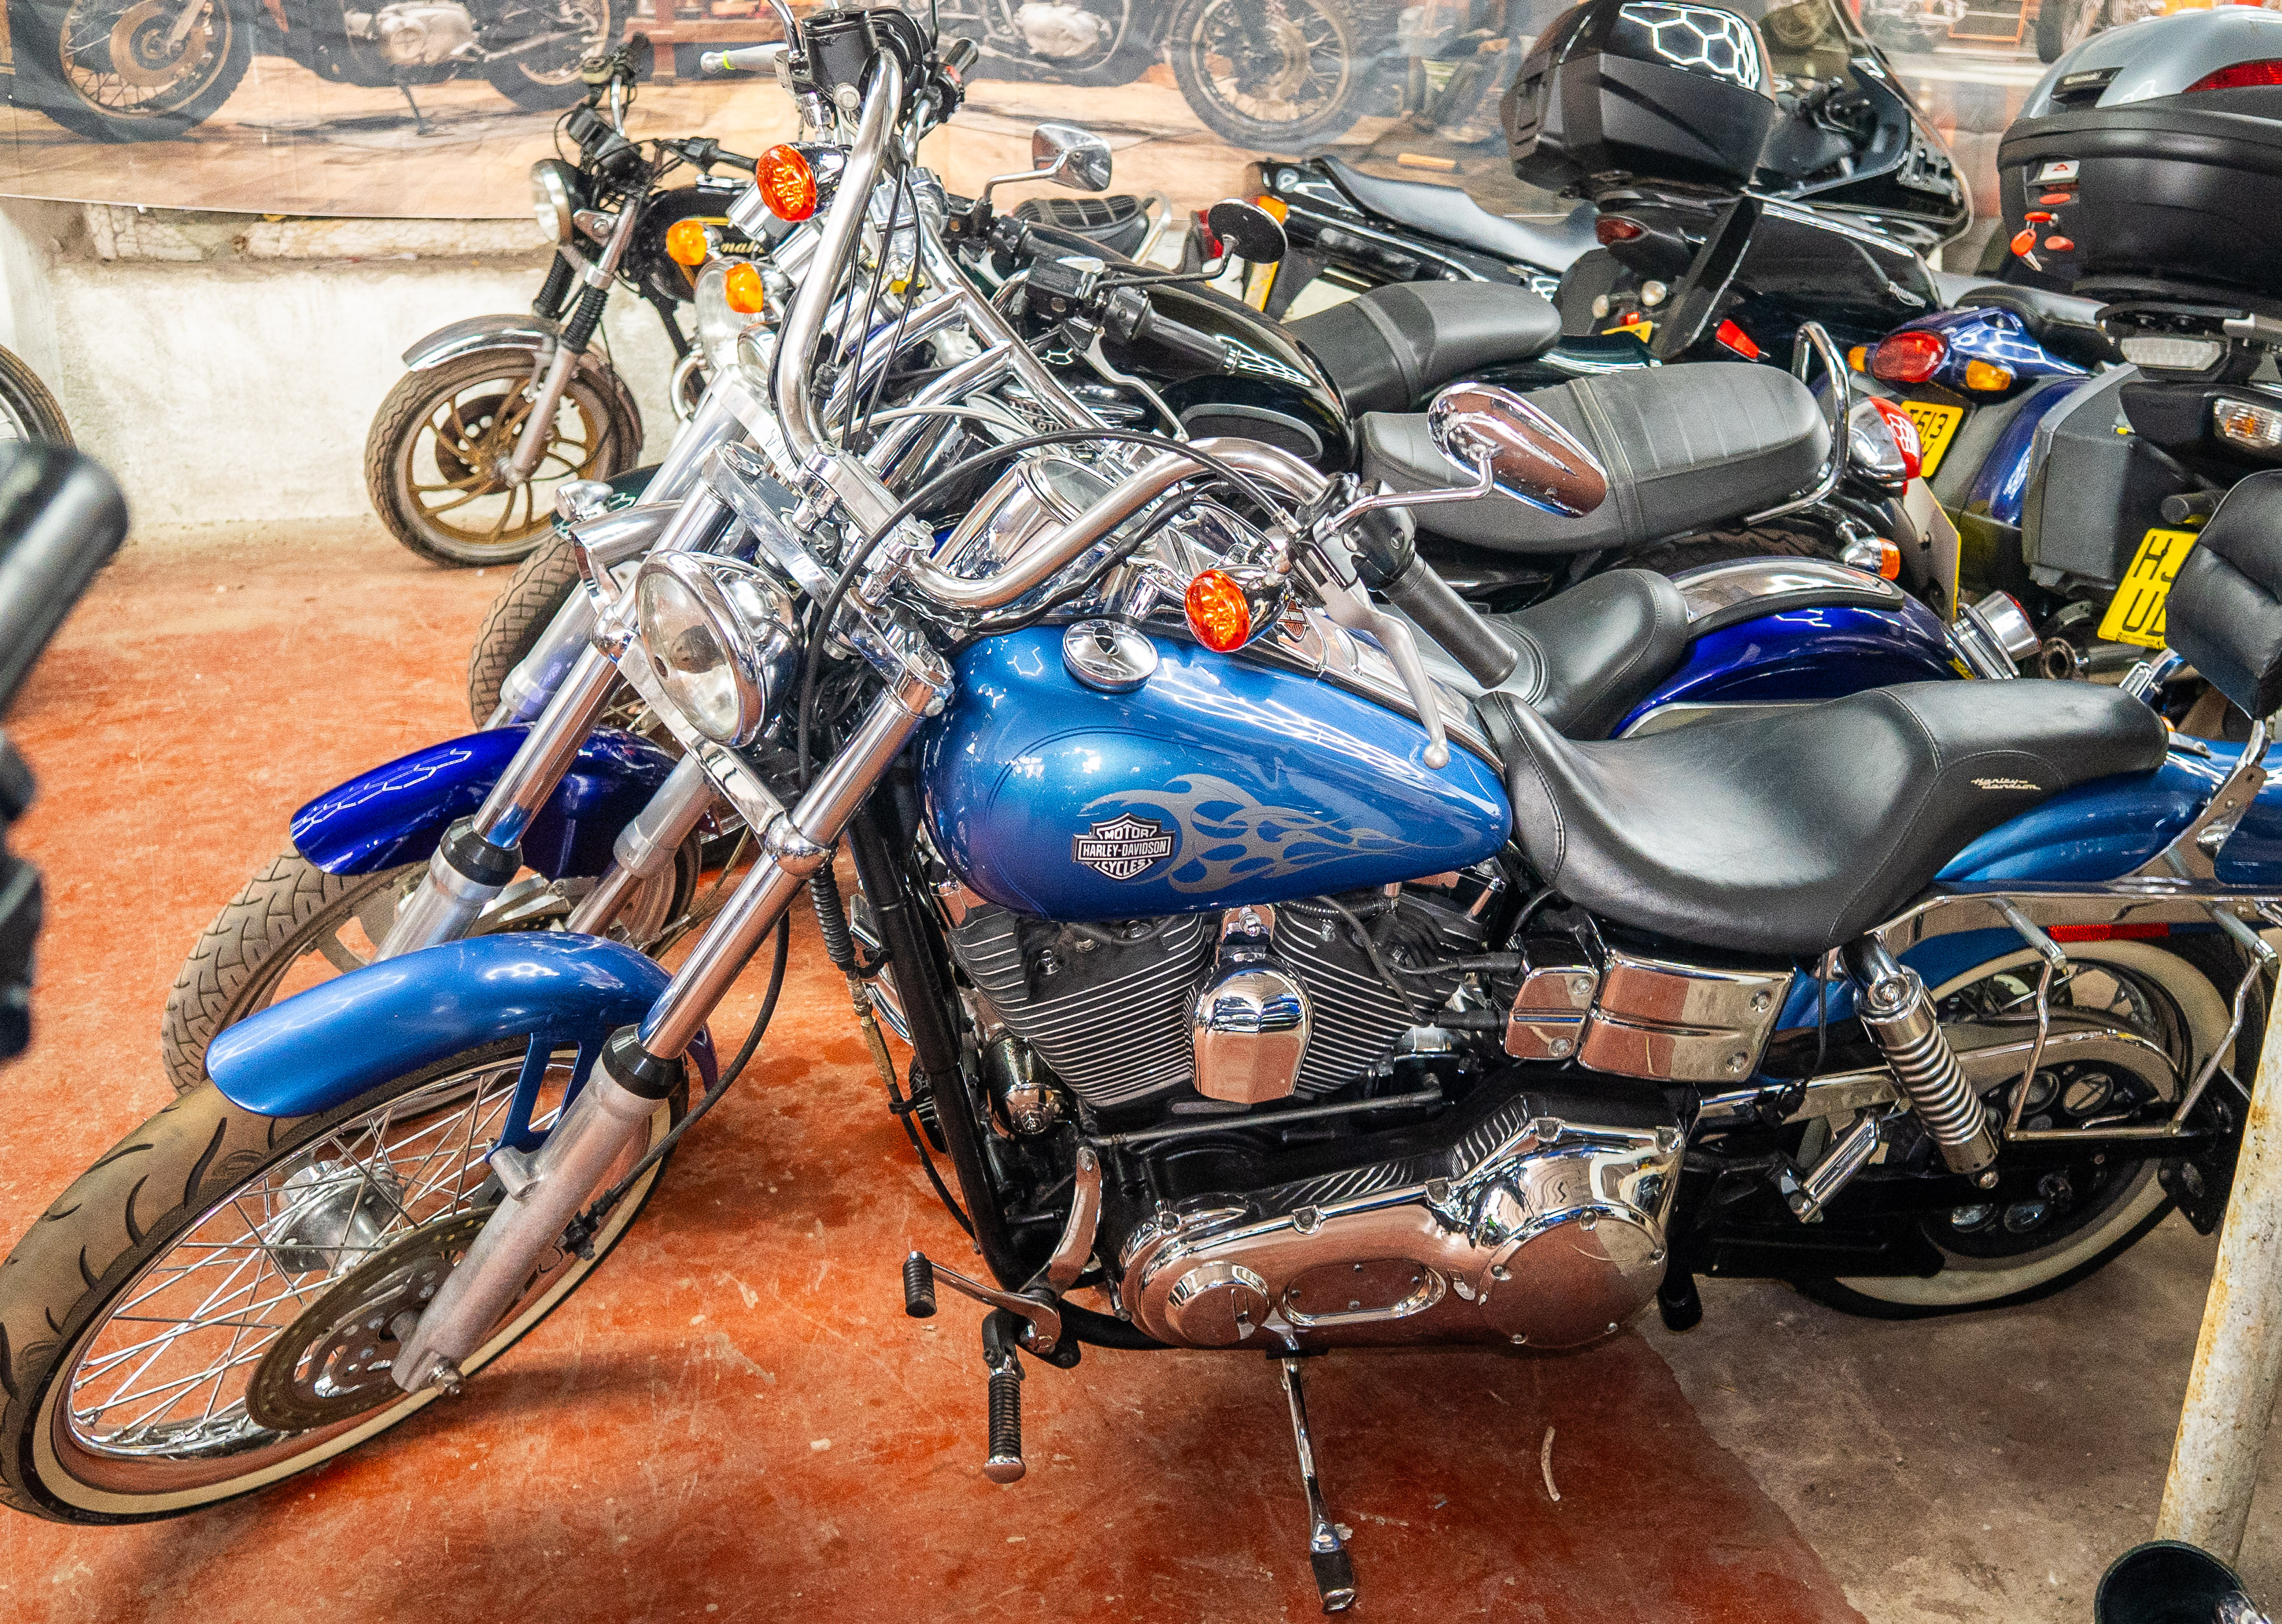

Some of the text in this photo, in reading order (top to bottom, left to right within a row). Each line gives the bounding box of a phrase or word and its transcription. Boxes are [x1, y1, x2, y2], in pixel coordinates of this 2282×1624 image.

[1104, 824, 1149, 839] MOTOR
[1082, 840, 1167, 857] HARLEY-DAVIDSON
[1101, 859, 1146, 876] CYCLES
